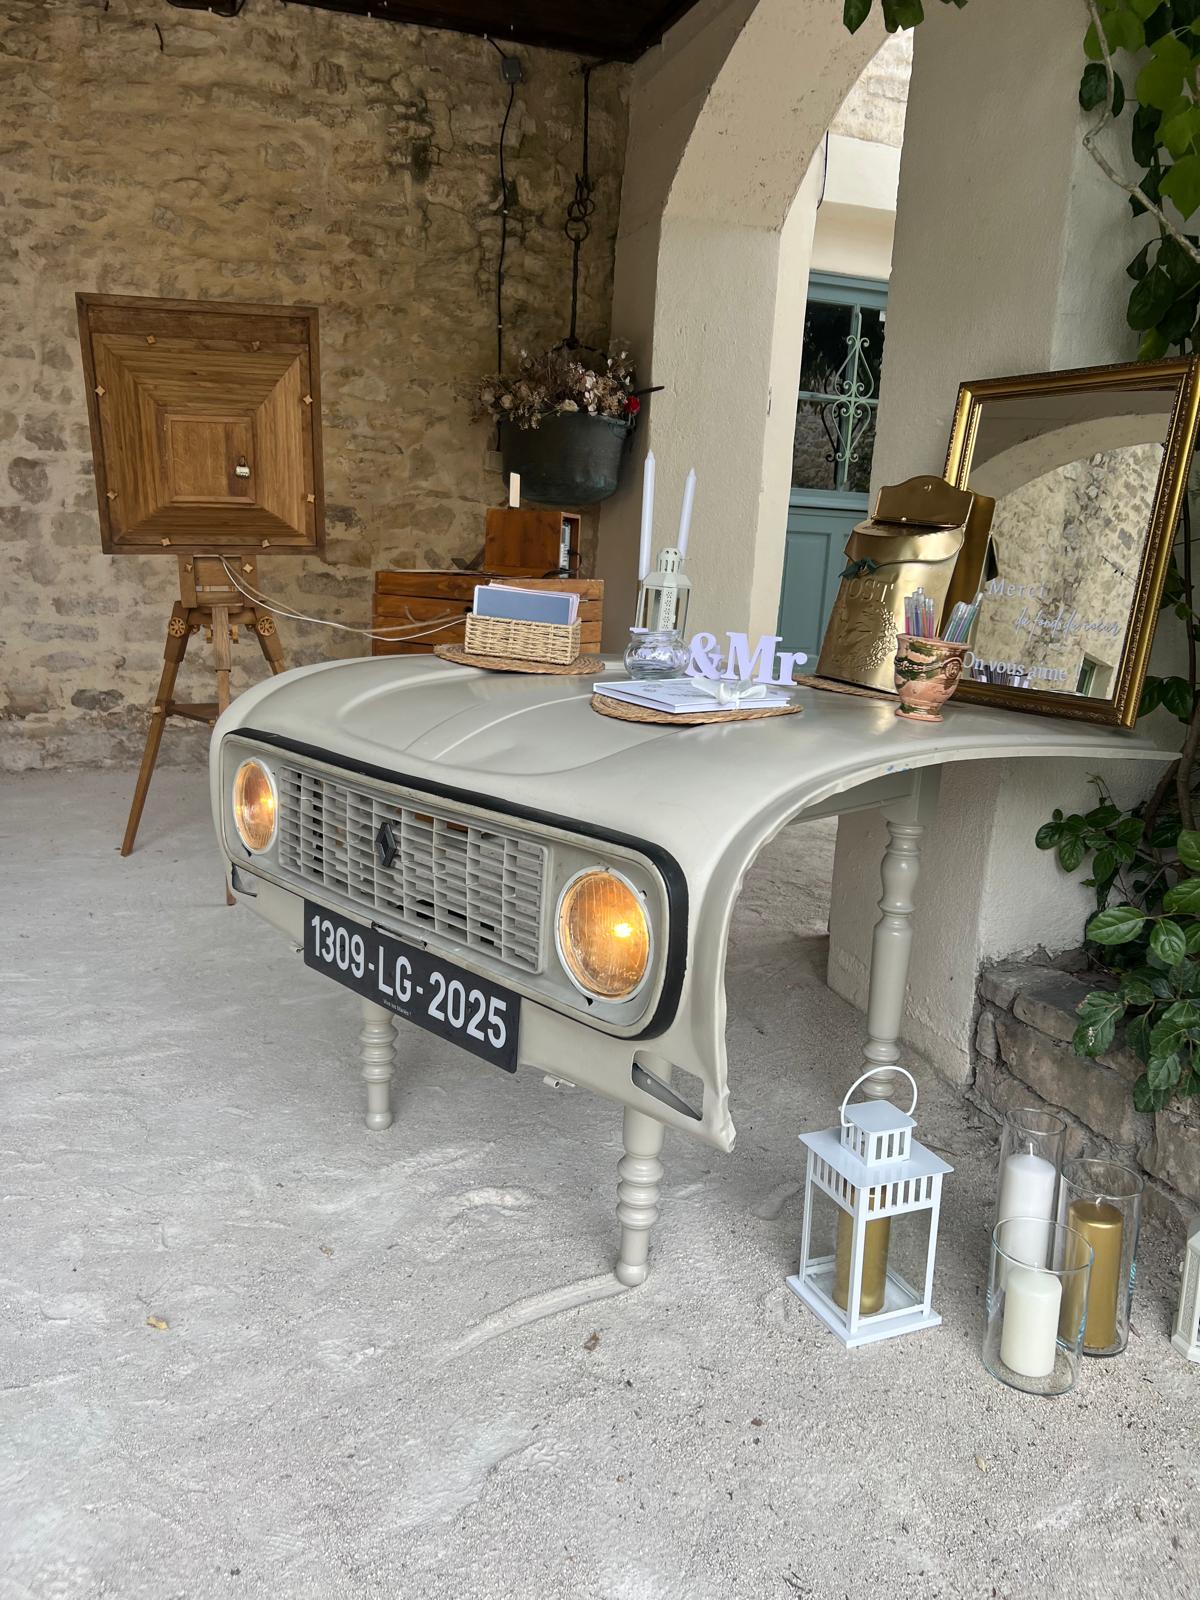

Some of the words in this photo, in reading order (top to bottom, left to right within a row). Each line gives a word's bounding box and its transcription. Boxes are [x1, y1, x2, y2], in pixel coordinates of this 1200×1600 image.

[843, 576, 895, 604] OST
[989, 577, 1045, 598] Merci
[963, 651, 985, 671] On
[989, 659, 1026, 676] vous
[1026, 665, 1068, 682] aime
[311, 915, 507, 1049] 1309-LG-2025
